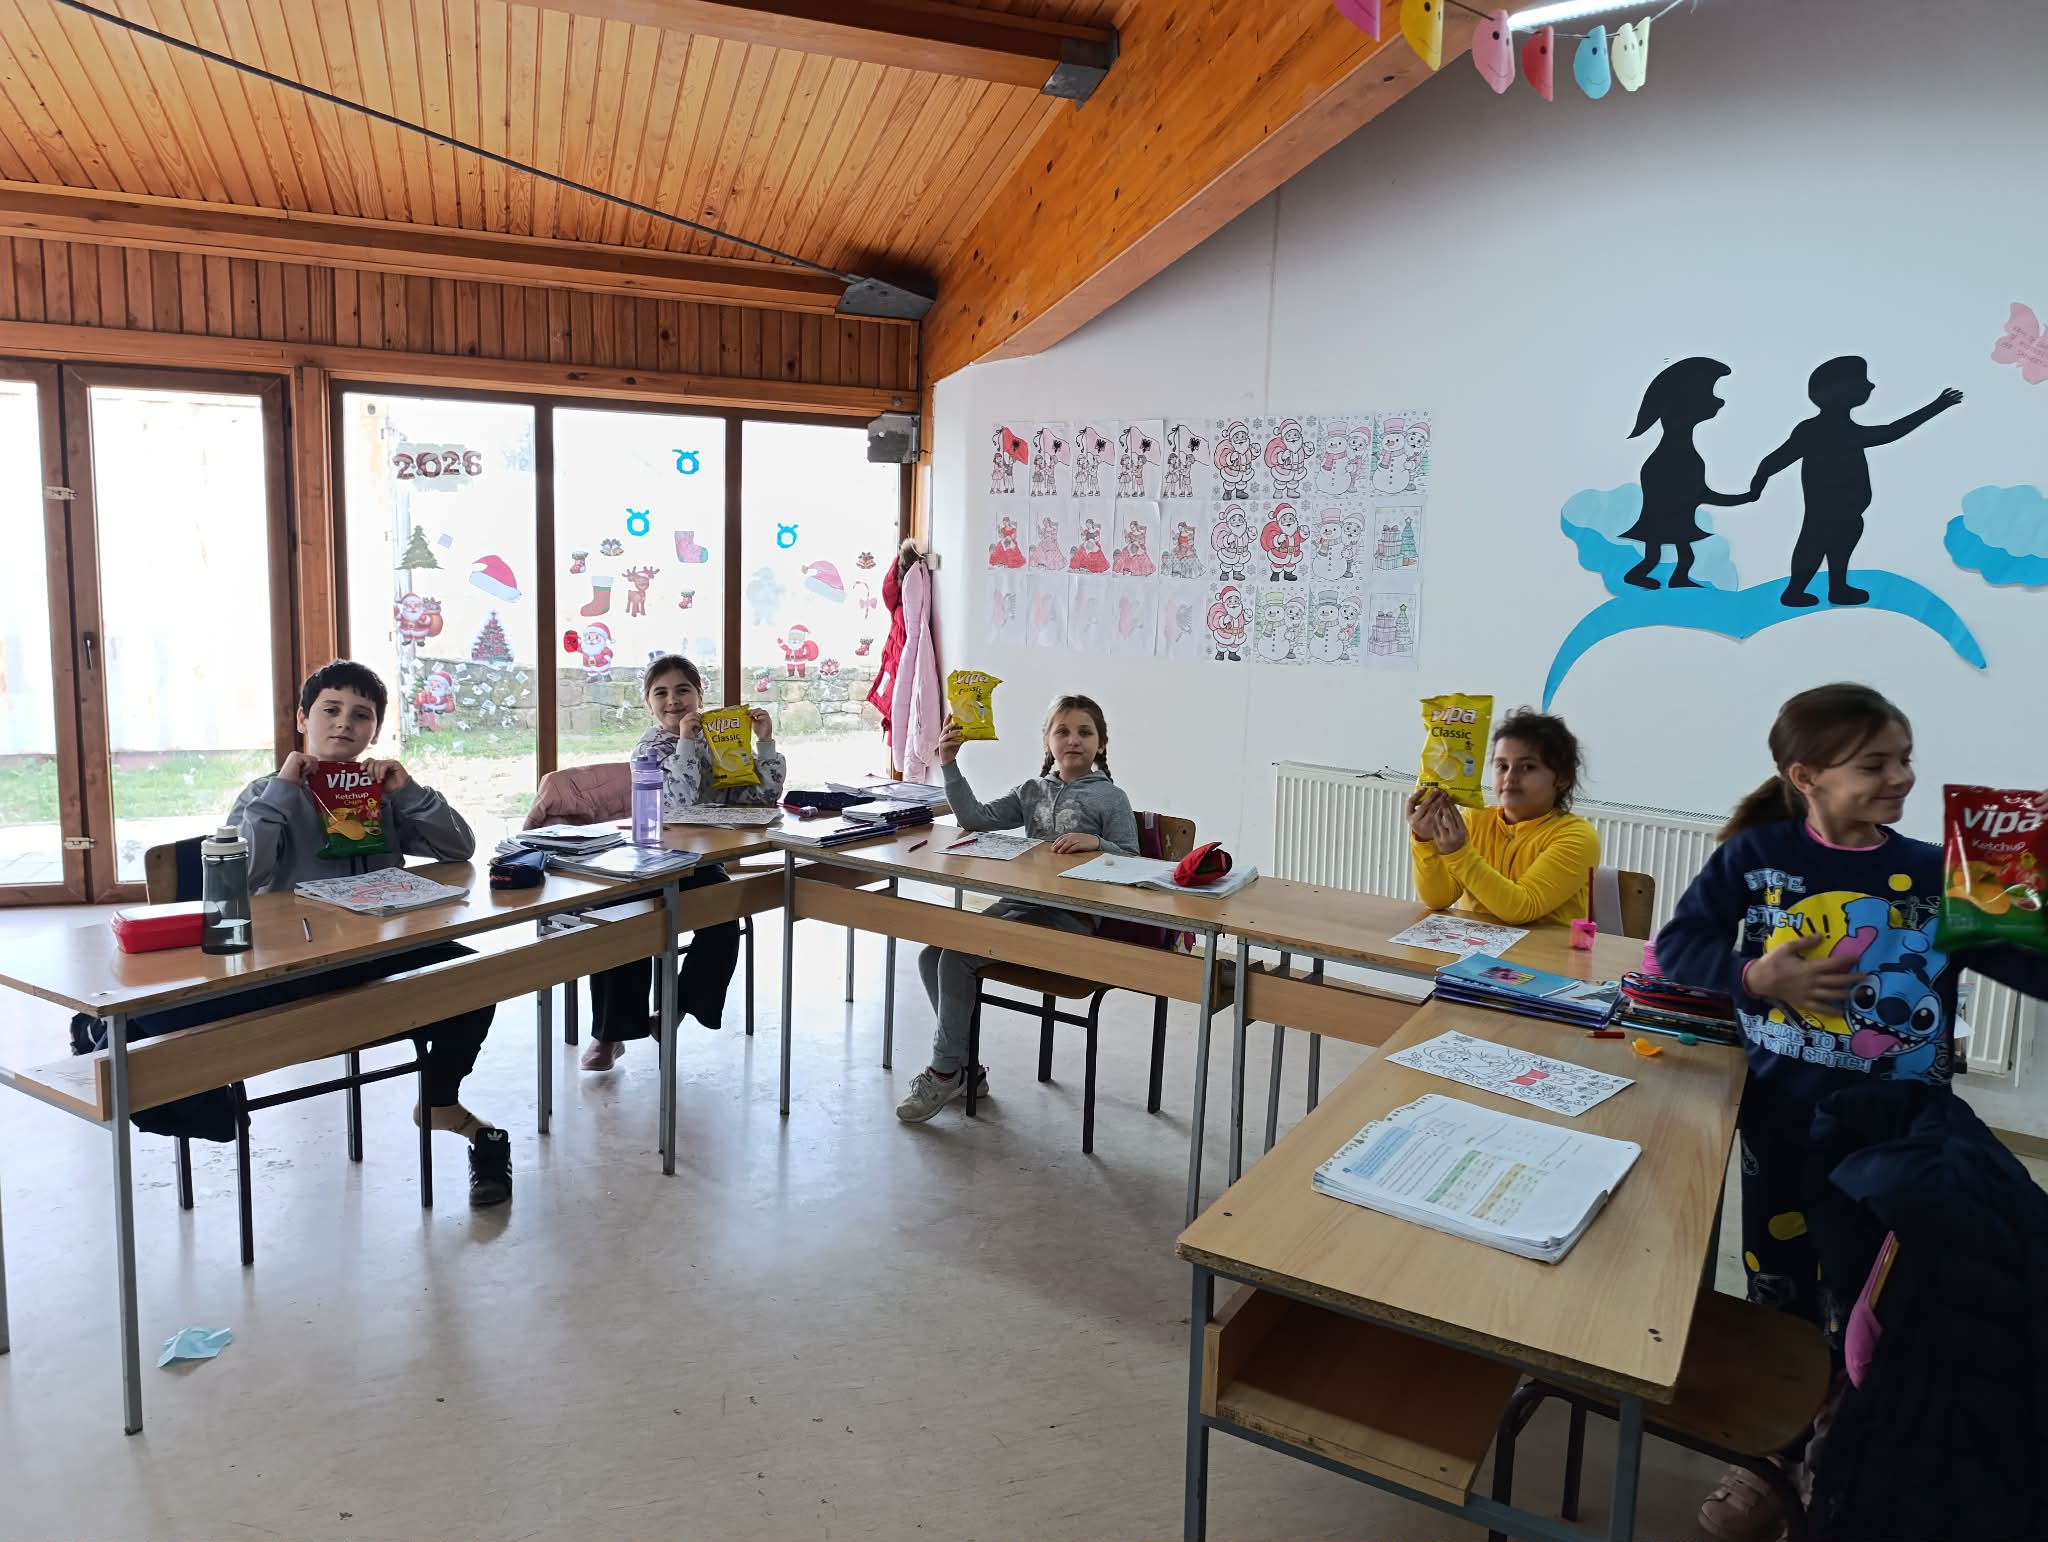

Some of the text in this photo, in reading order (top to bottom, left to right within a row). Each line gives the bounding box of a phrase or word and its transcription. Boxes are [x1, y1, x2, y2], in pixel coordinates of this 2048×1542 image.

[392, 450, 482, 480] 2026
[1431, 706, 1478, 725] vipa
[706, 717, 740, 733] vipa
[1431, 726, 1472, 740] Classic
[711, 733, 741, 743] Classic
[326, 769, 373, 791] vipa
[335, 791, 369, 800] Ketchup
[1963, 803, 2043, 838] vipa
[1971, 840, 2027, 852] Ketchup
[1809, 1029, 1836, 1052] TO
